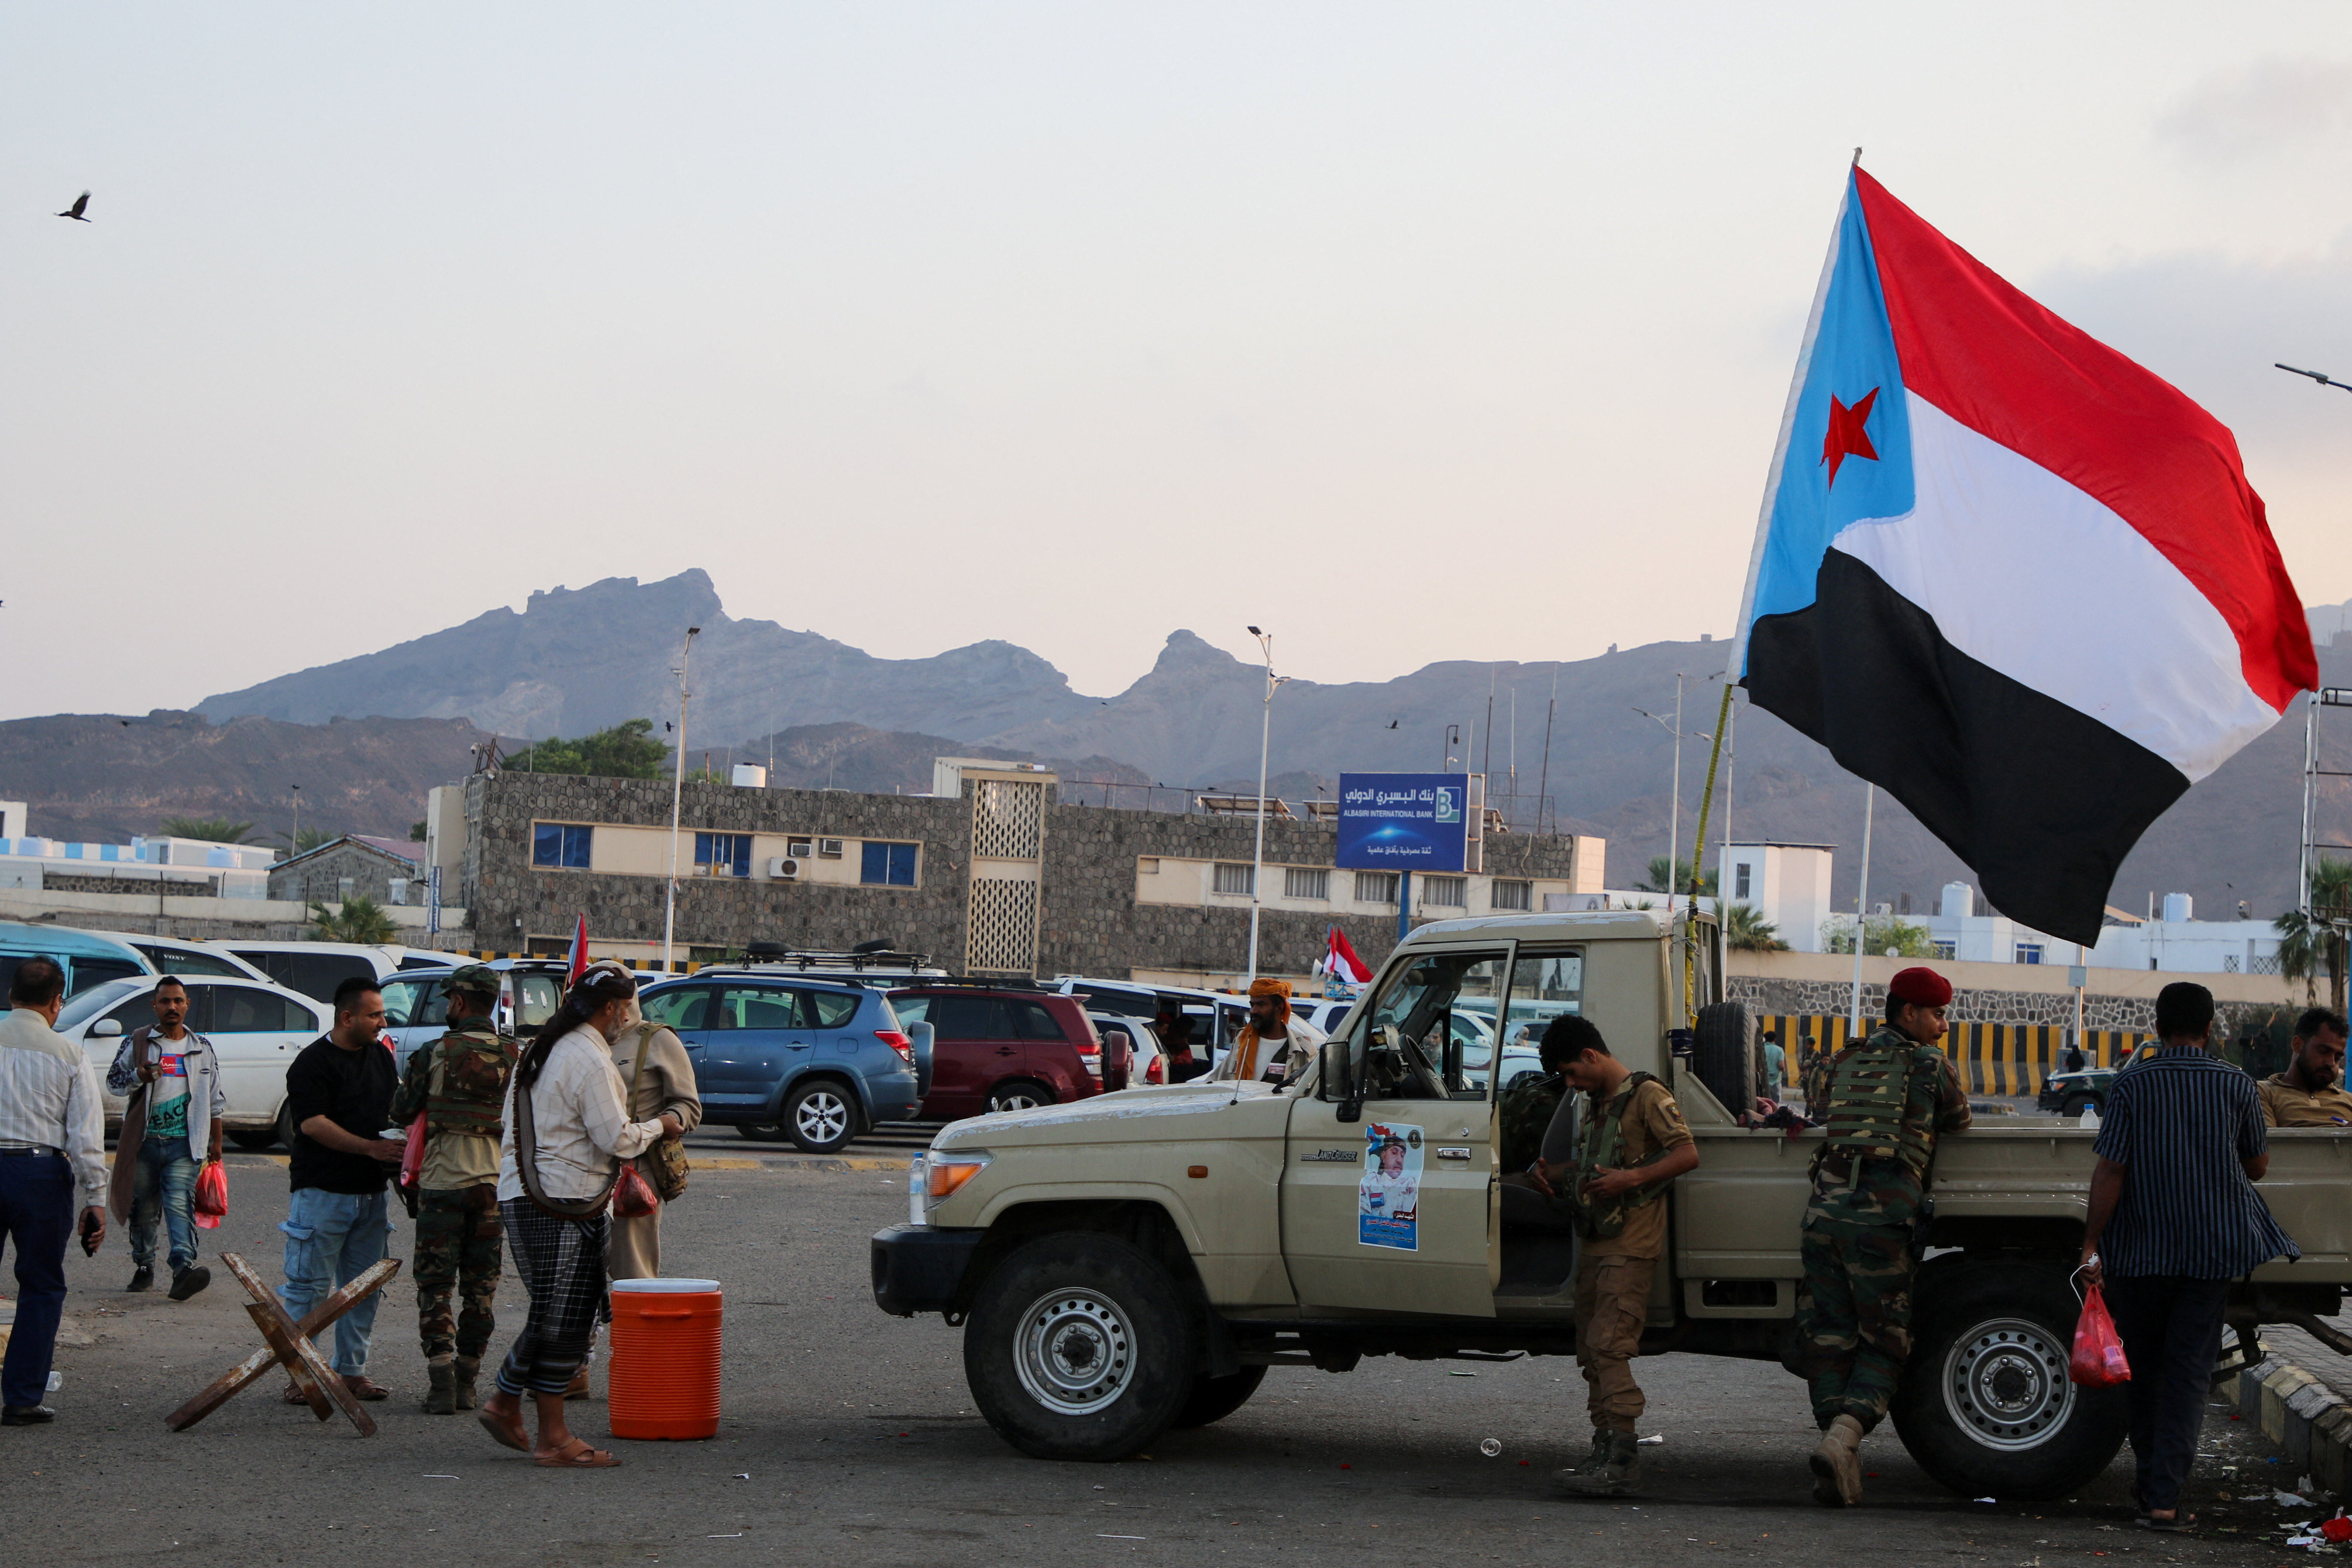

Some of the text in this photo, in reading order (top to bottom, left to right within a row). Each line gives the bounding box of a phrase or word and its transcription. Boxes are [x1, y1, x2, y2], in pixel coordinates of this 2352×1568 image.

[1345, 789, 1434, 805] بنك البسيري الدولي
[1367, 846, 1384, 855] عالمية
[1400, 846, 1420, 855] مصرفية
[1421, 846, 1431, 854] ثقة
